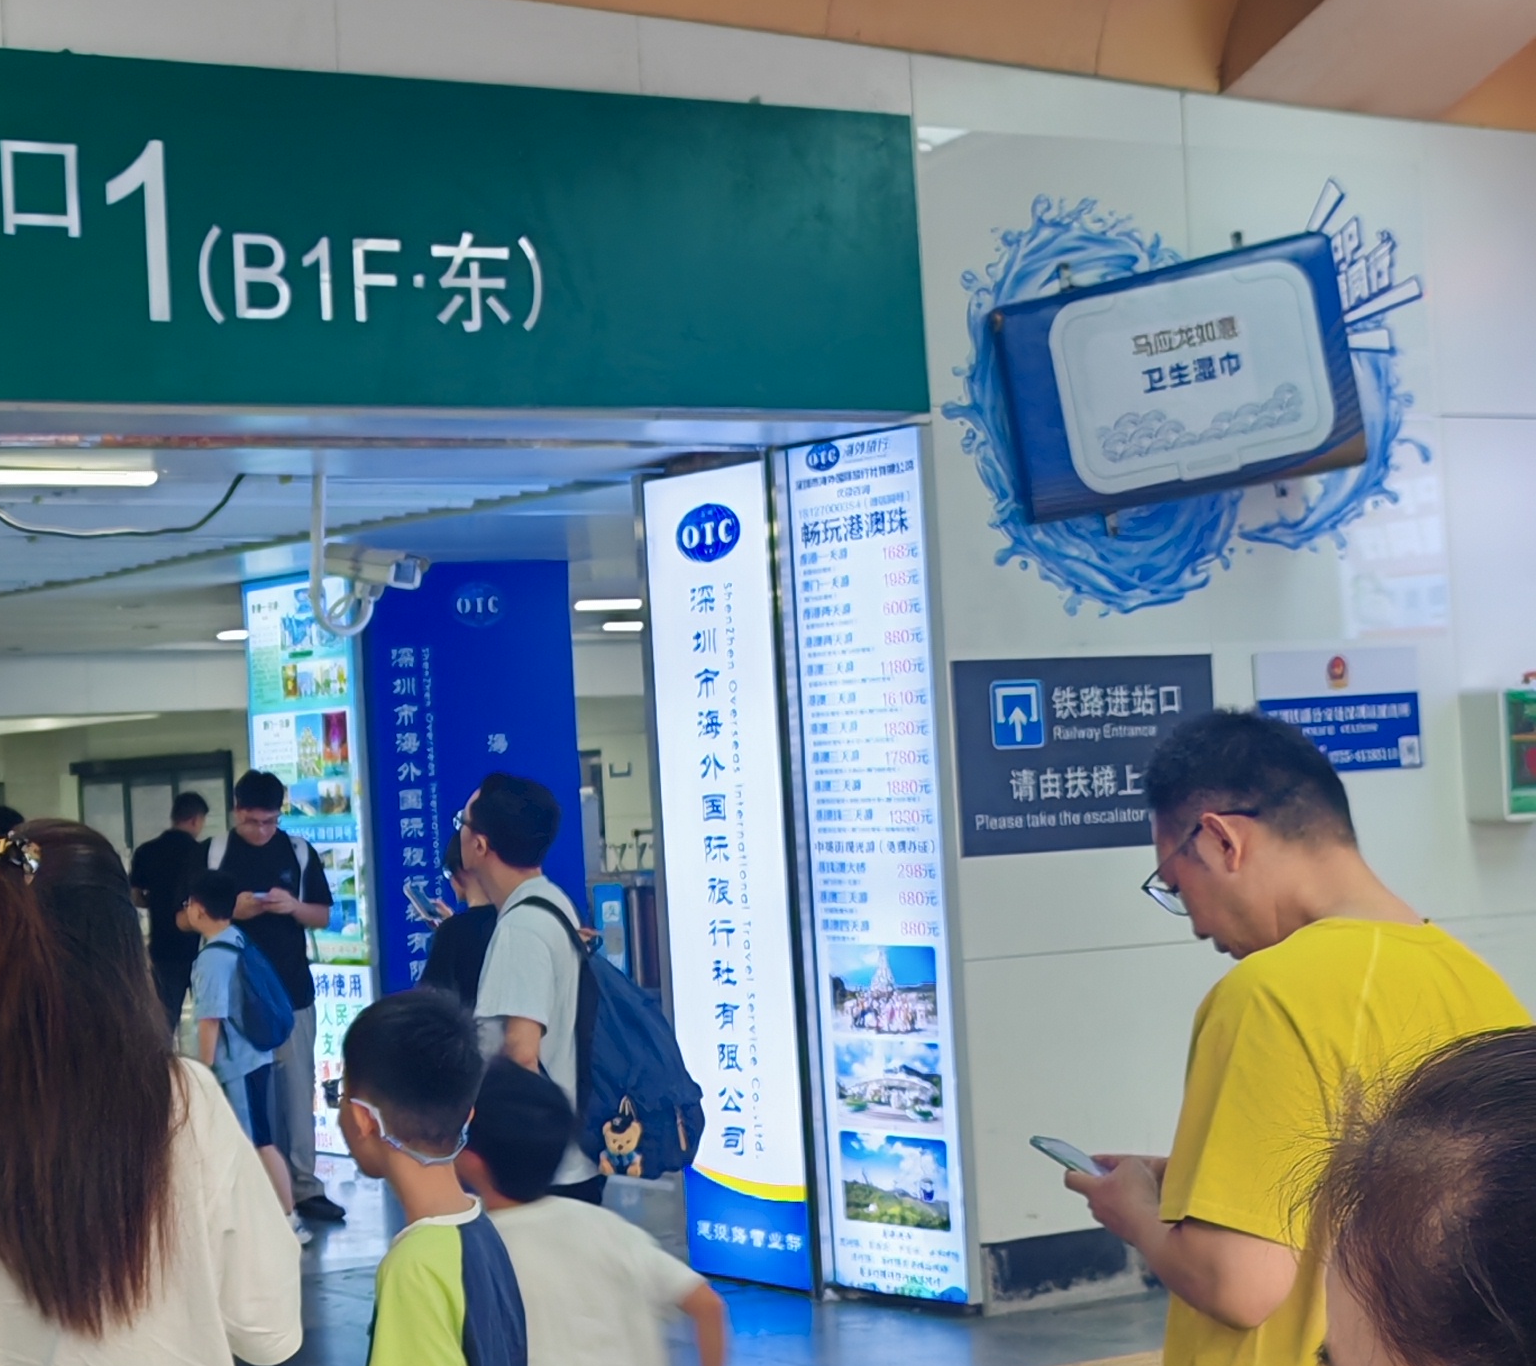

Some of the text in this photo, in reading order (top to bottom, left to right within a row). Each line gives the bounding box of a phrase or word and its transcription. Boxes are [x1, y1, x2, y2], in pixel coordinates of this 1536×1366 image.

[105, 139, 172, 323] 1
[1141, 351, 1242, 395] 卫生湿巾
[681, 517, 734, 550] OTC
[1051, 685, 1182, 719] 铁路进站口
[1052, 722, 1158, 742] Railway Entrance
[1009, 764, 1146, 803] 请由扶梯上
[974, 808, 1146, 831] Please take the escalator
[690, 584, 747, 1157] 深圳市海外国际旅行社有限公司
